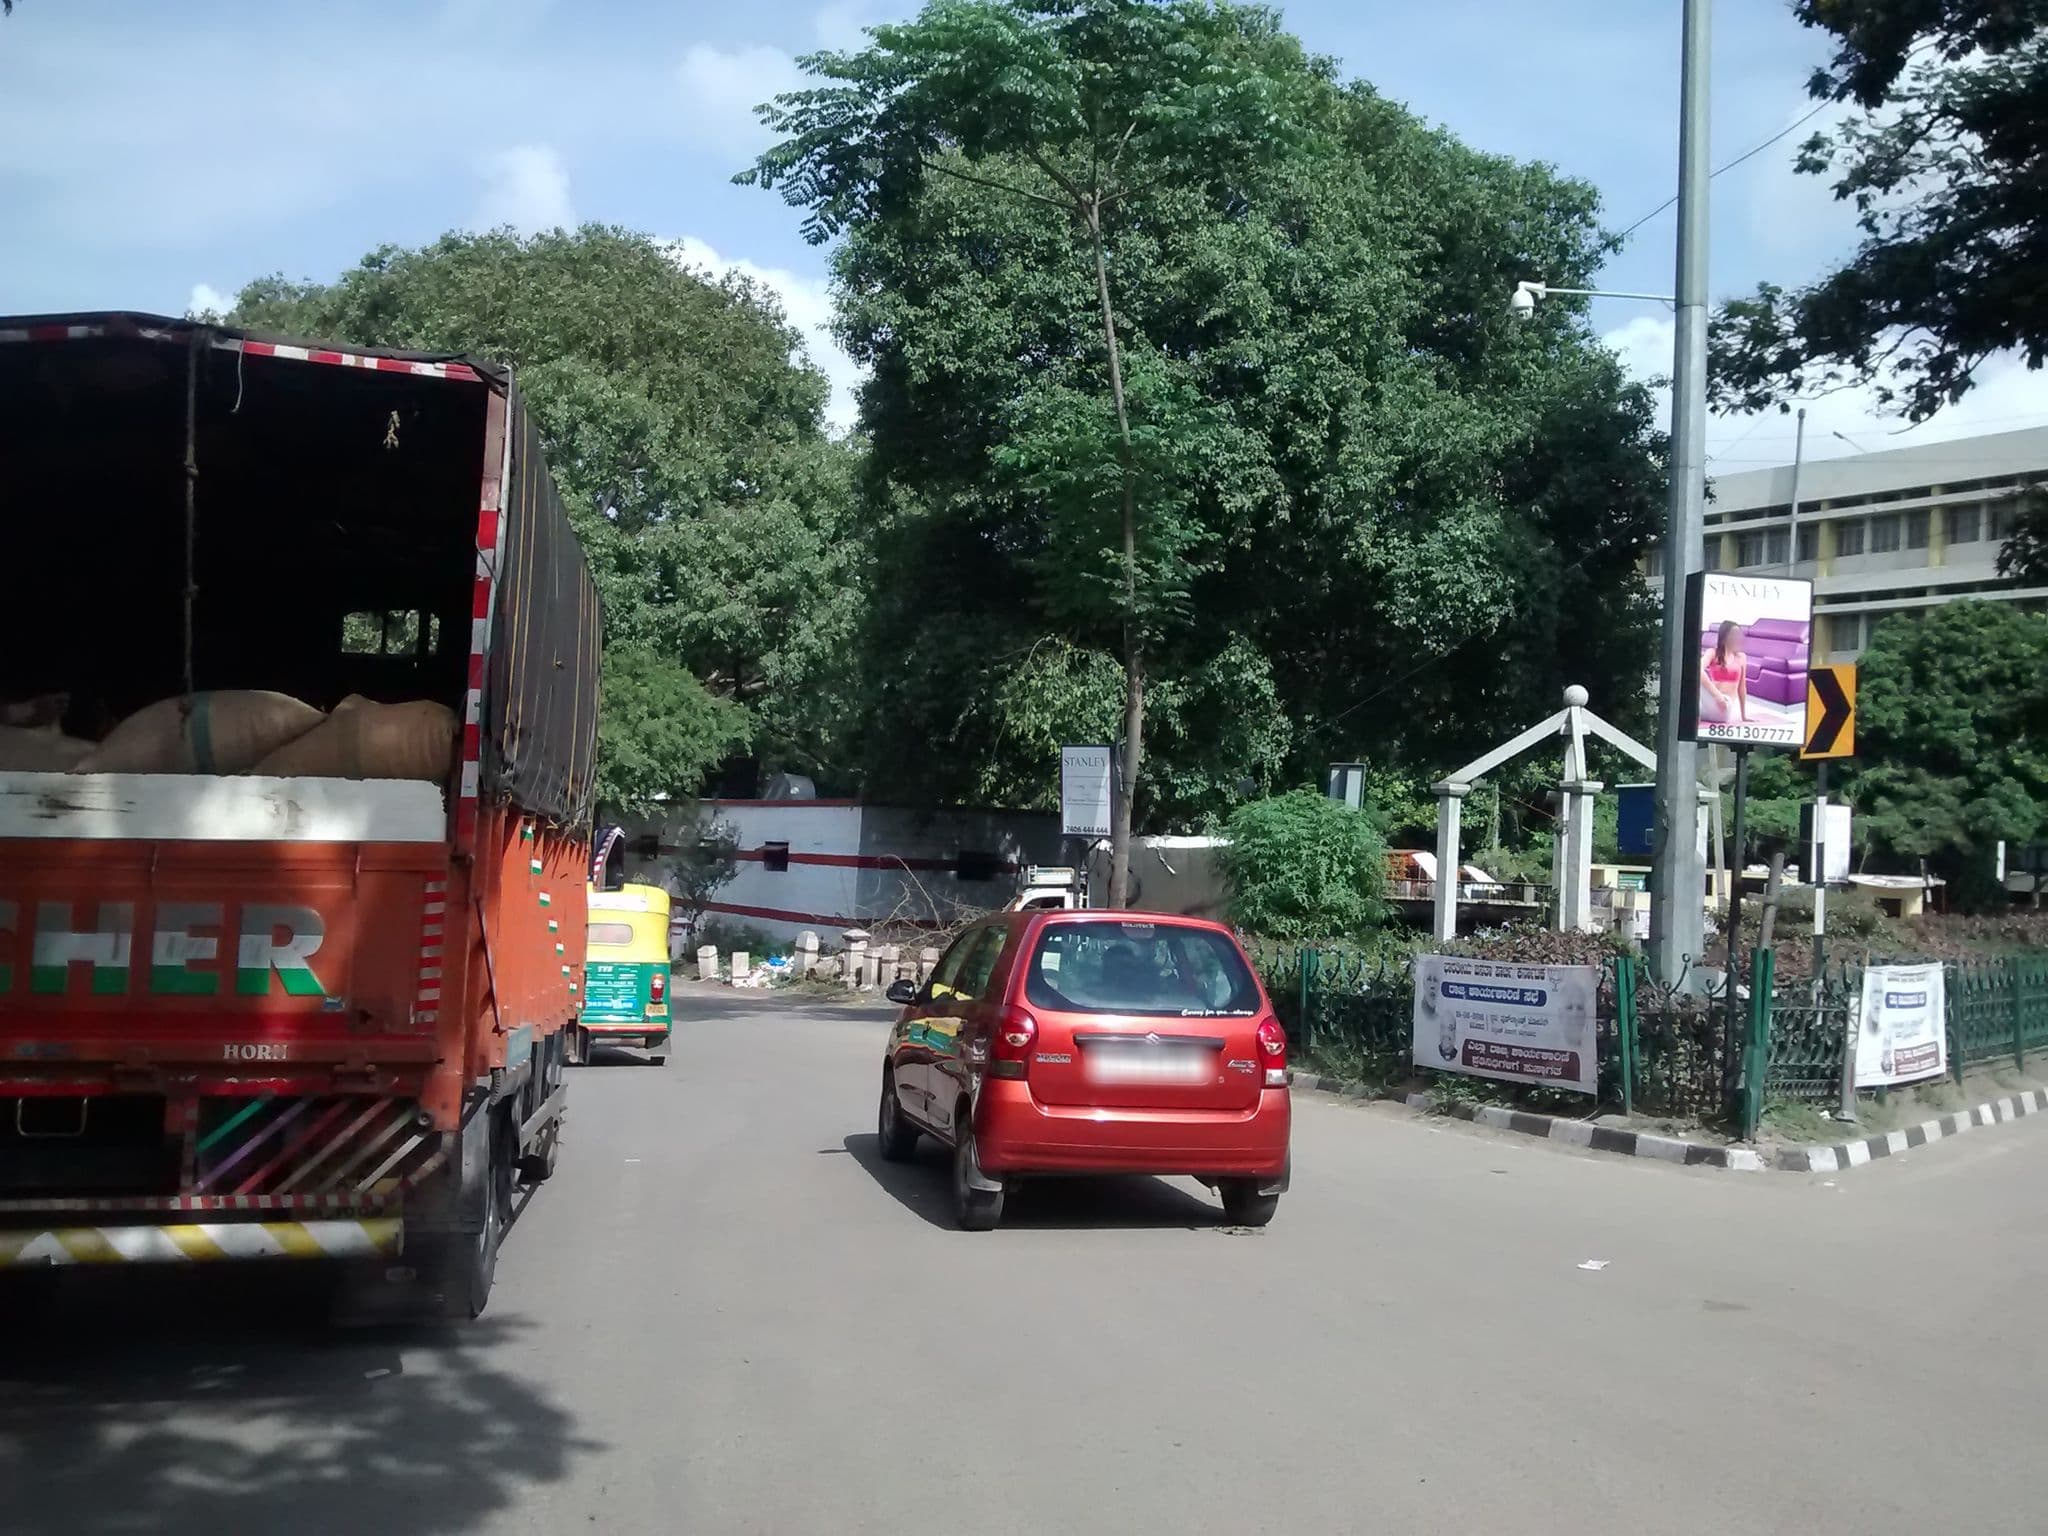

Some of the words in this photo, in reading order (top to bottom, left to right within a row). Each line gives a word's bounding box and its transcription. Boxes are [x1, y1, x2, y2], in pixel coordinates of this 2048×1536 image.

[1708, 581, 1784, 600] STANLEY
[1708, 724, 1794, 741] 8861307777
[1064, 756, 1106, 767] STANLEY
[0, 902, 327, 995] HER
[223, 1043, 288, 1061] HORN
